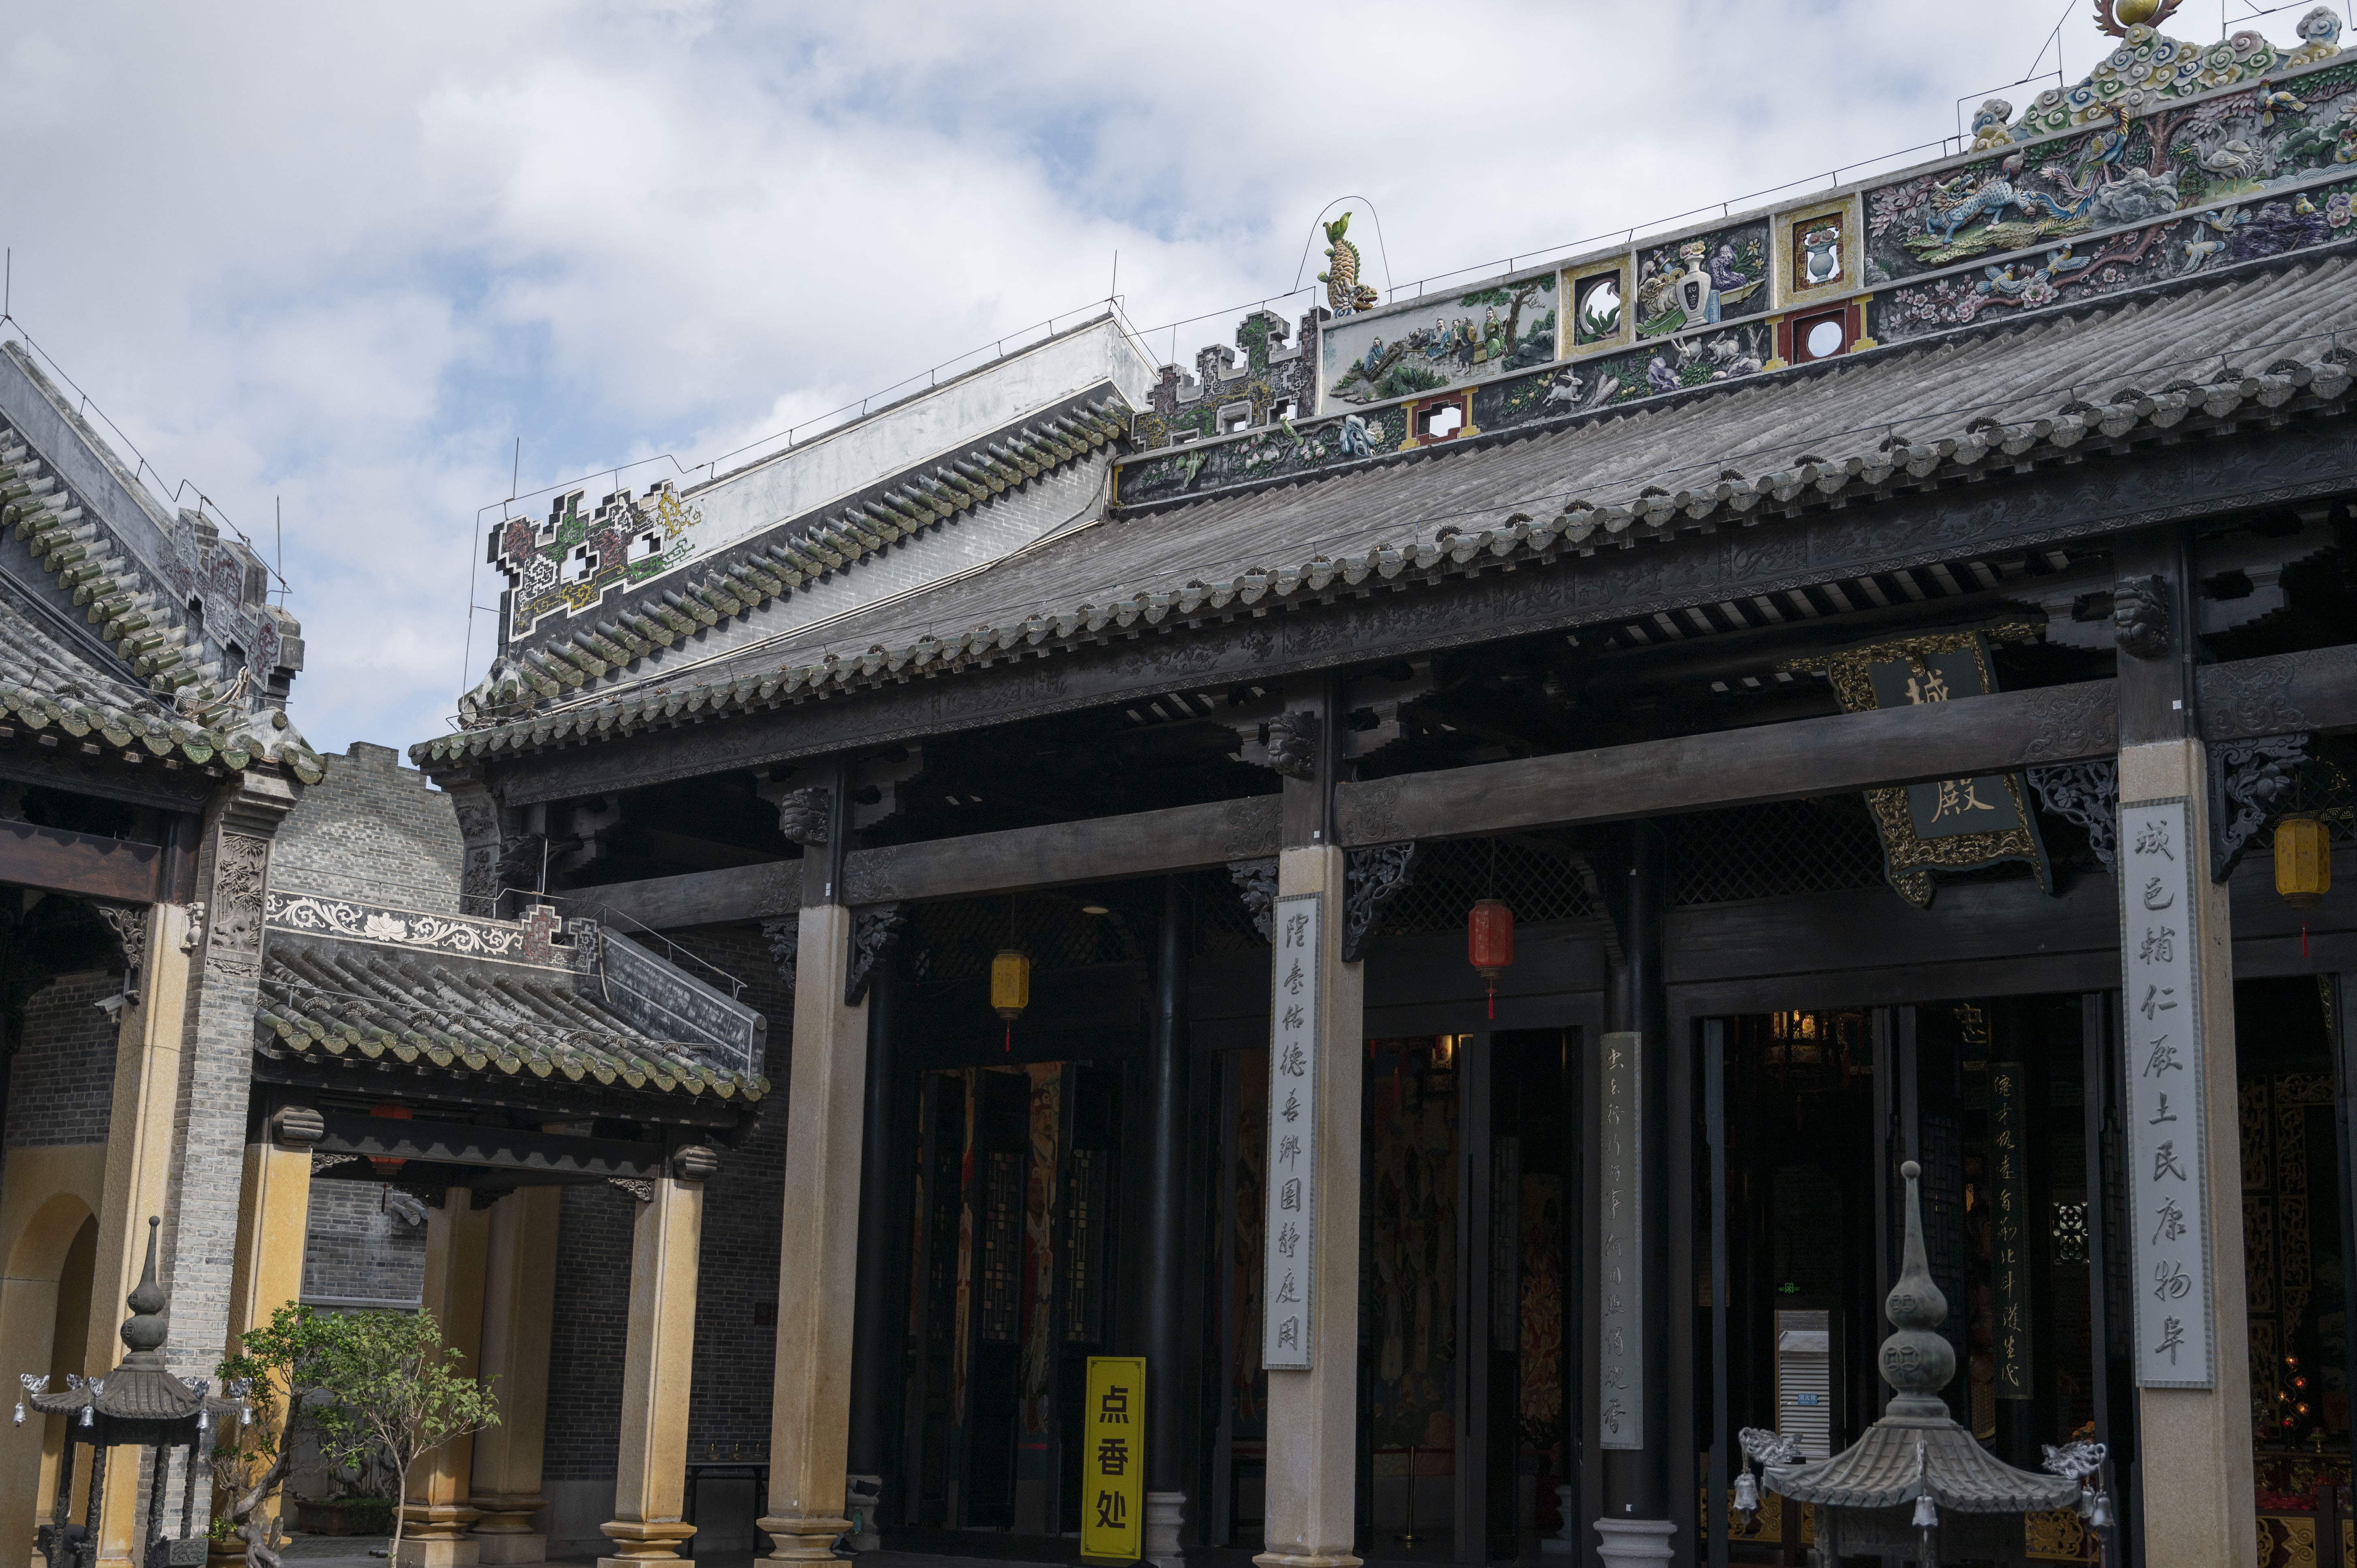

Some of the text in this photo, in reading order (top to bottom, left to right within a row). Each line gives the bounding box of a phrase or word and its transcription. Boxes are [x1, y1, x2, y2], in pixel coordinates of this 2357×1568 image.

[1687, 285, 1697, 308] 如意
[1095, 1385, 1129, 1529] 点香处
